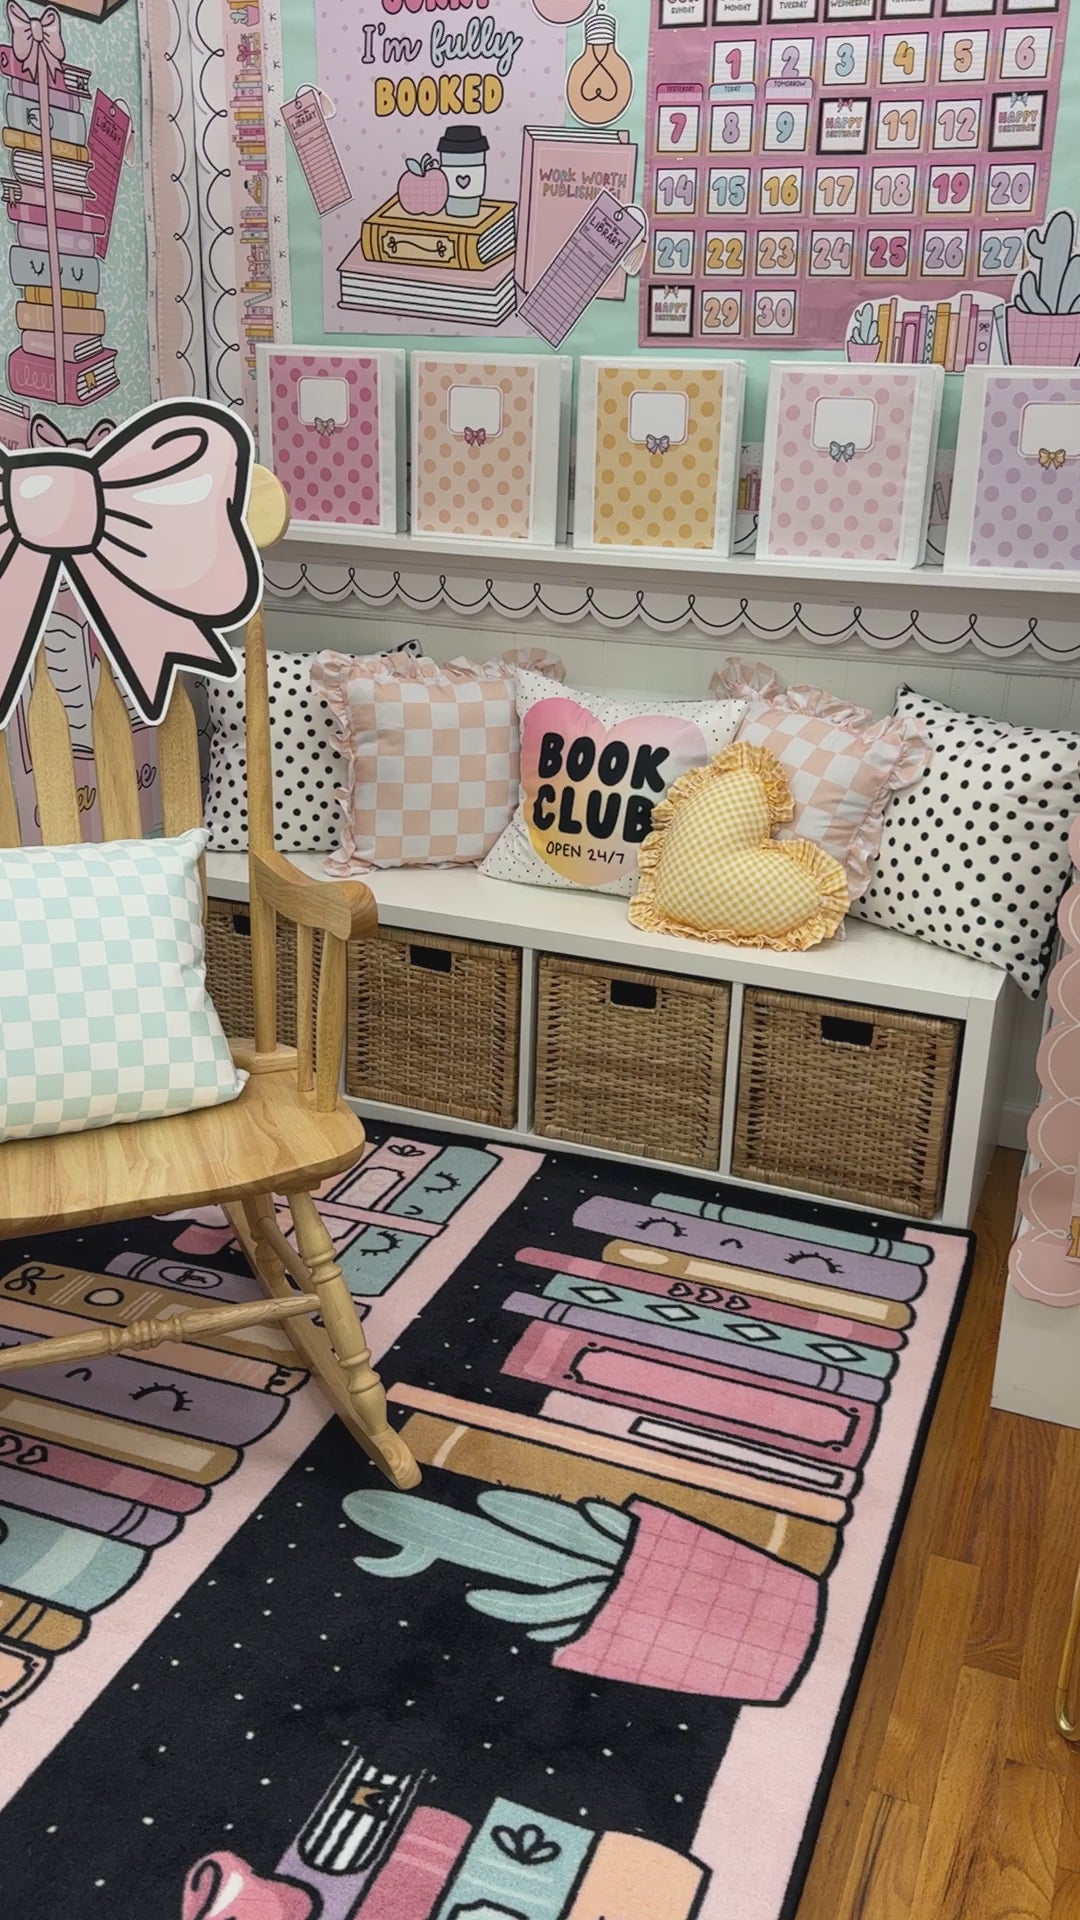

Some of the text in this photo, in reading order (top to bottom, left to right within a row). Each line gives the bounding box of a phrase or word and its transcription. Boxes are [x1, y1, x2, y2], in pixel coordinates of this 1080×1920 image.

[724, 3, 752, 12] MONDAY
[361, 16, 523, 77] I'm fully
[781, 45, 801, 77] 2
[834, 42, 855, 77] 3
[893, 40, 915, 75] 4
[953, 38, 974, 73] 5
[1015, 35, 1035, 70] 6
[725, 48, 742, 81] 1
[375, 73, 504, 117] BOOKED
[669, 112, 687, 144] 7
[722, 111, 741, 144] 8
[776, 110, 795, 143] 9
[825, 116, 863, 129] HAPPY
[882, 109, 918, 141] 11
[938, 107, 976, 141] 12
[998, 110, 1039, 124] HAPPY
[539, 167, 627, 188] WORK WORTH
[658, 174, 693, 206] 14
[711, 174, 745, 206] 15
[764, 174, 798, 206] 16
[819, 174, 855, 206] 17
[873, 173, 911, 206] 18
[932, 172, 970, 204] 19
[991, 172, 1031, 205] 20
[590, 215, 624, 250] LIBRARY
[657, 236, 691, 268] 21
[706, 237, 743, 268] 22
[759, 236, 795, 268] 23
[812, 236, 850, 269] 24
[869, 236, 907, 268] 25
[925, 236, 964, 268] 26
[982, 236, 1022, 268] 27
[654, 302, 688, 313] HAPPY
[704, 297, 739, 328] 29
[757, 297, 792, 328] 30
[538, 732, 670, 793] BOOK
[533, 784, 655, 843] CLUB
[546, 841, 625, 864] OPEN 24/7
